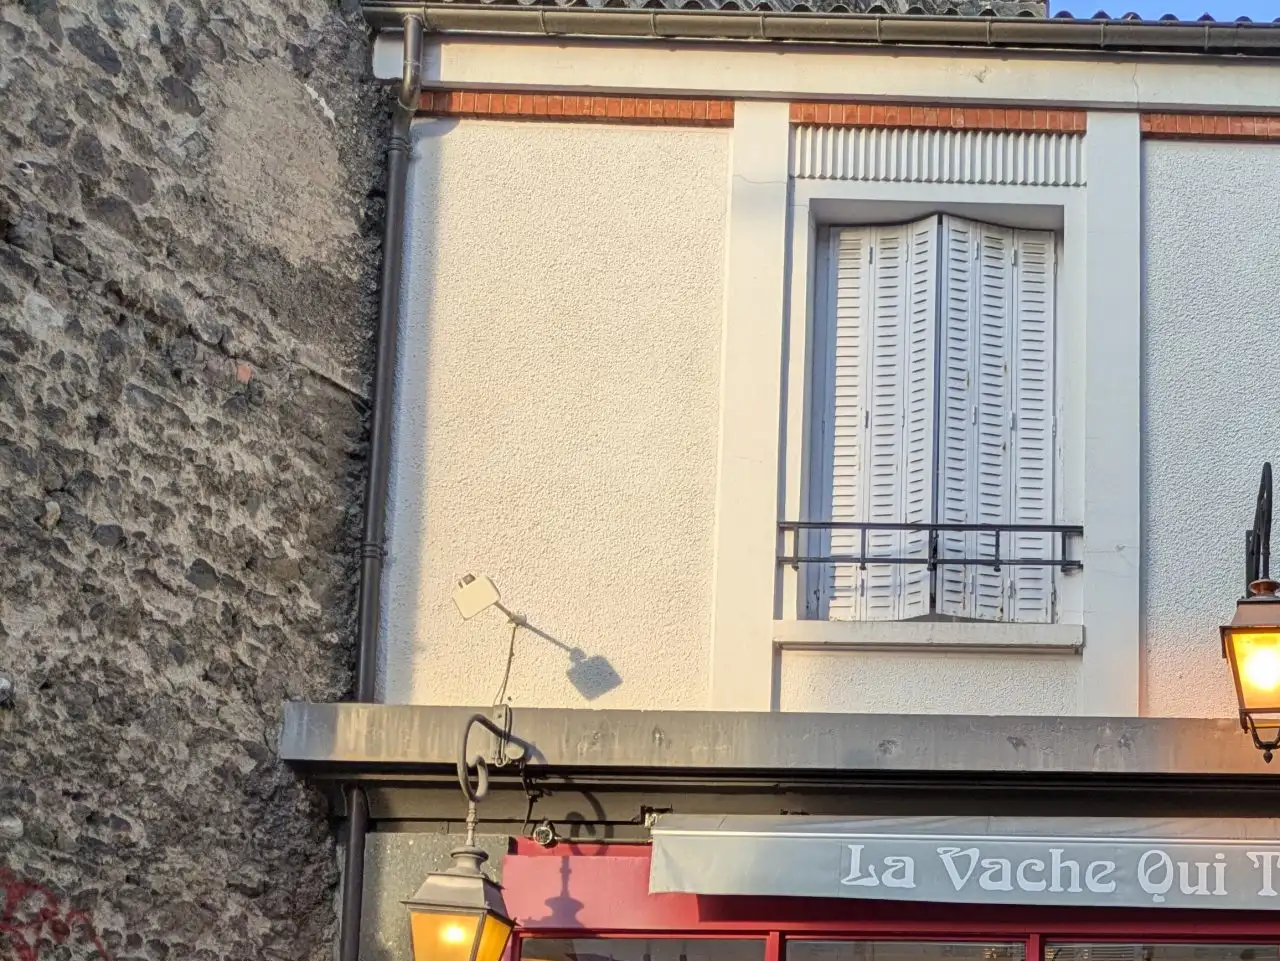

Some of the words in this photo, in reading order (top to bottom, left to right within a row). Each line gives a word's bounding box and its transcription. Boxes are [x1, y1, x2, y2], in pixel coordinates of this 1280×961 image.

[840, 844, 916, 890] La
[935, 847, 1117, 894] Vache
[1137, 849, 1229, 903] Qui
